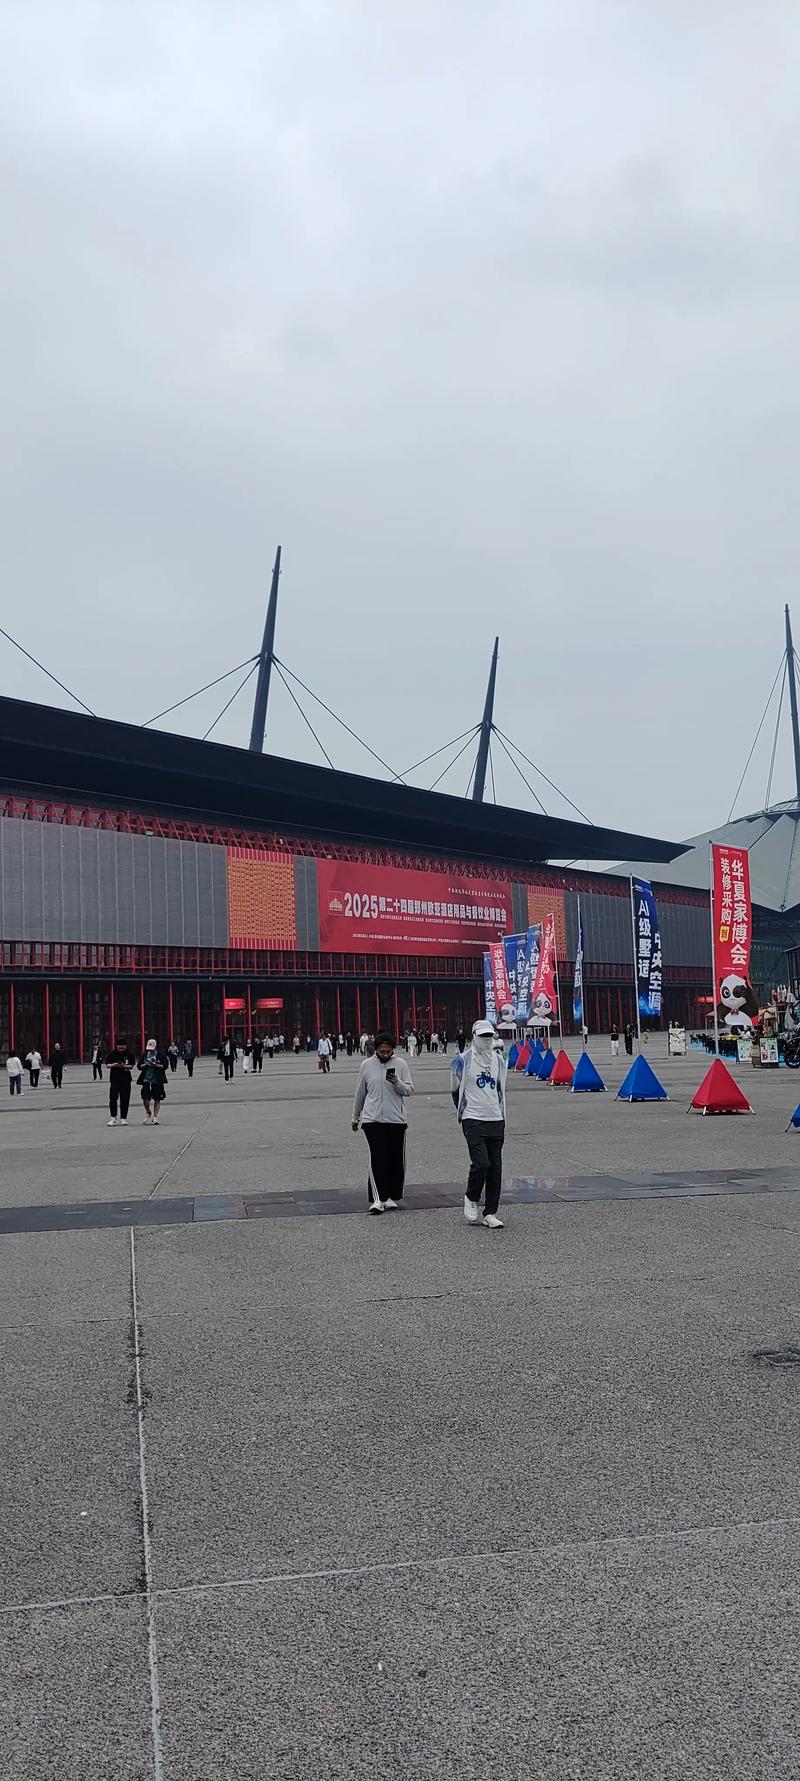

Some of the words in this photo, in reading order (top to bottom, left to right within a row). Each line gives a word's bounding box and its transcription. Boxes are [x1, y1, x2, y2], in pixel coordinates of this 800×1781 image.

[720, 858, 732, 925] 装修采购
[730, 859, 748, 965] 华夏家博会
